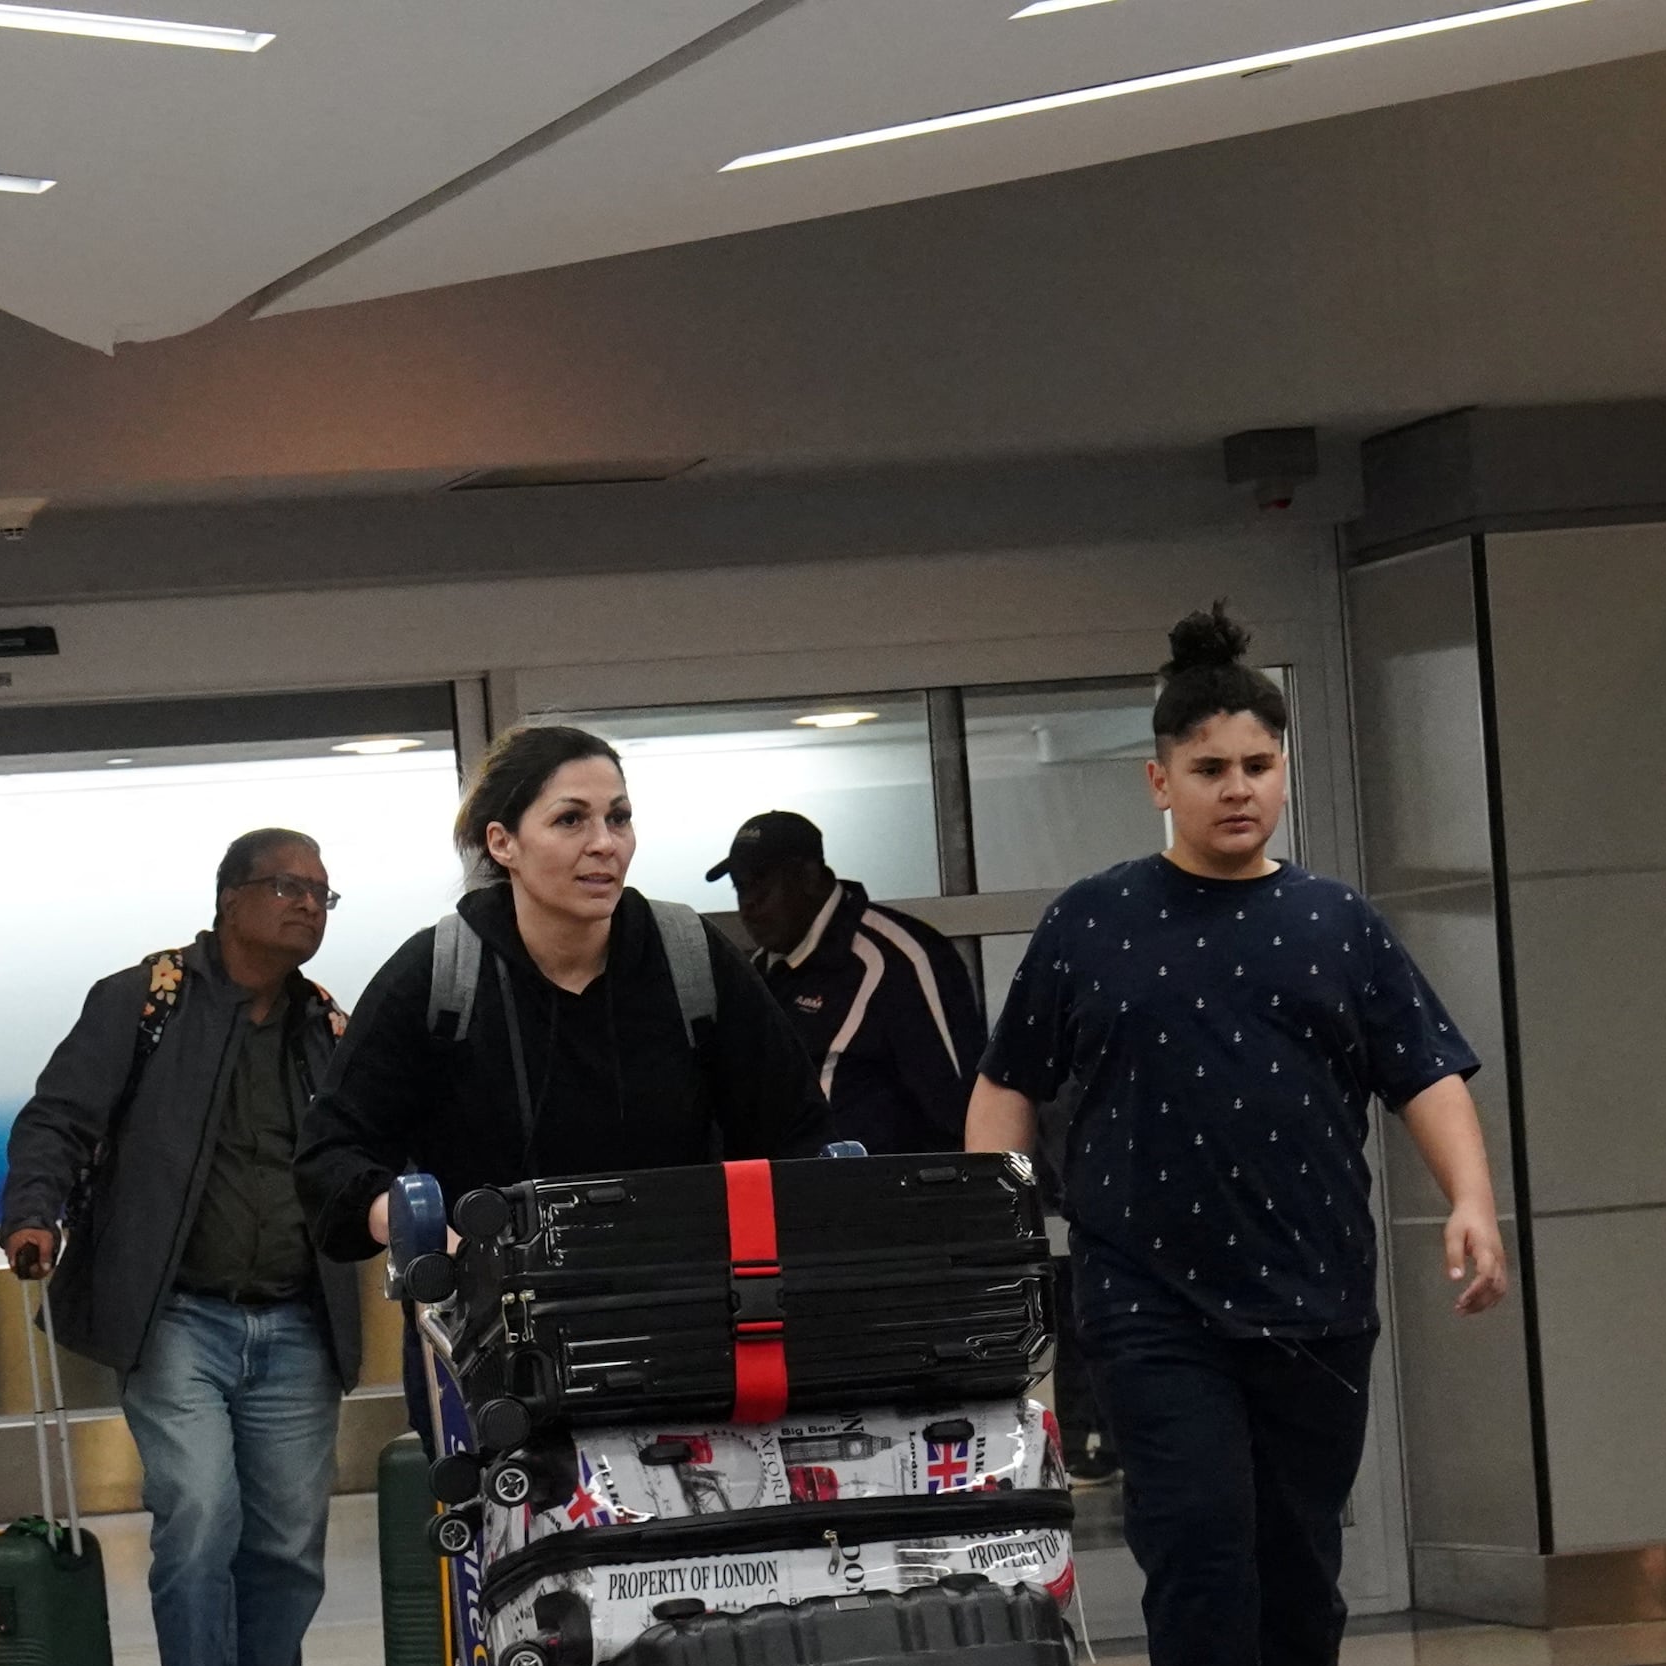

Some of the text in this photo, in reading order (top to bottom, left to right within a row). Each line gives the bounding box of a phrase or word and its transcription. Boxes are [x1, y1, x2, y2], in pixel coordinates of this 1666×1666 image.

[780, 1424, 836, 1437] Big Ben
[909, 1431, 918, 1489] London
[608, 1560, 779, 1600] PROPERTY OF LONDON
